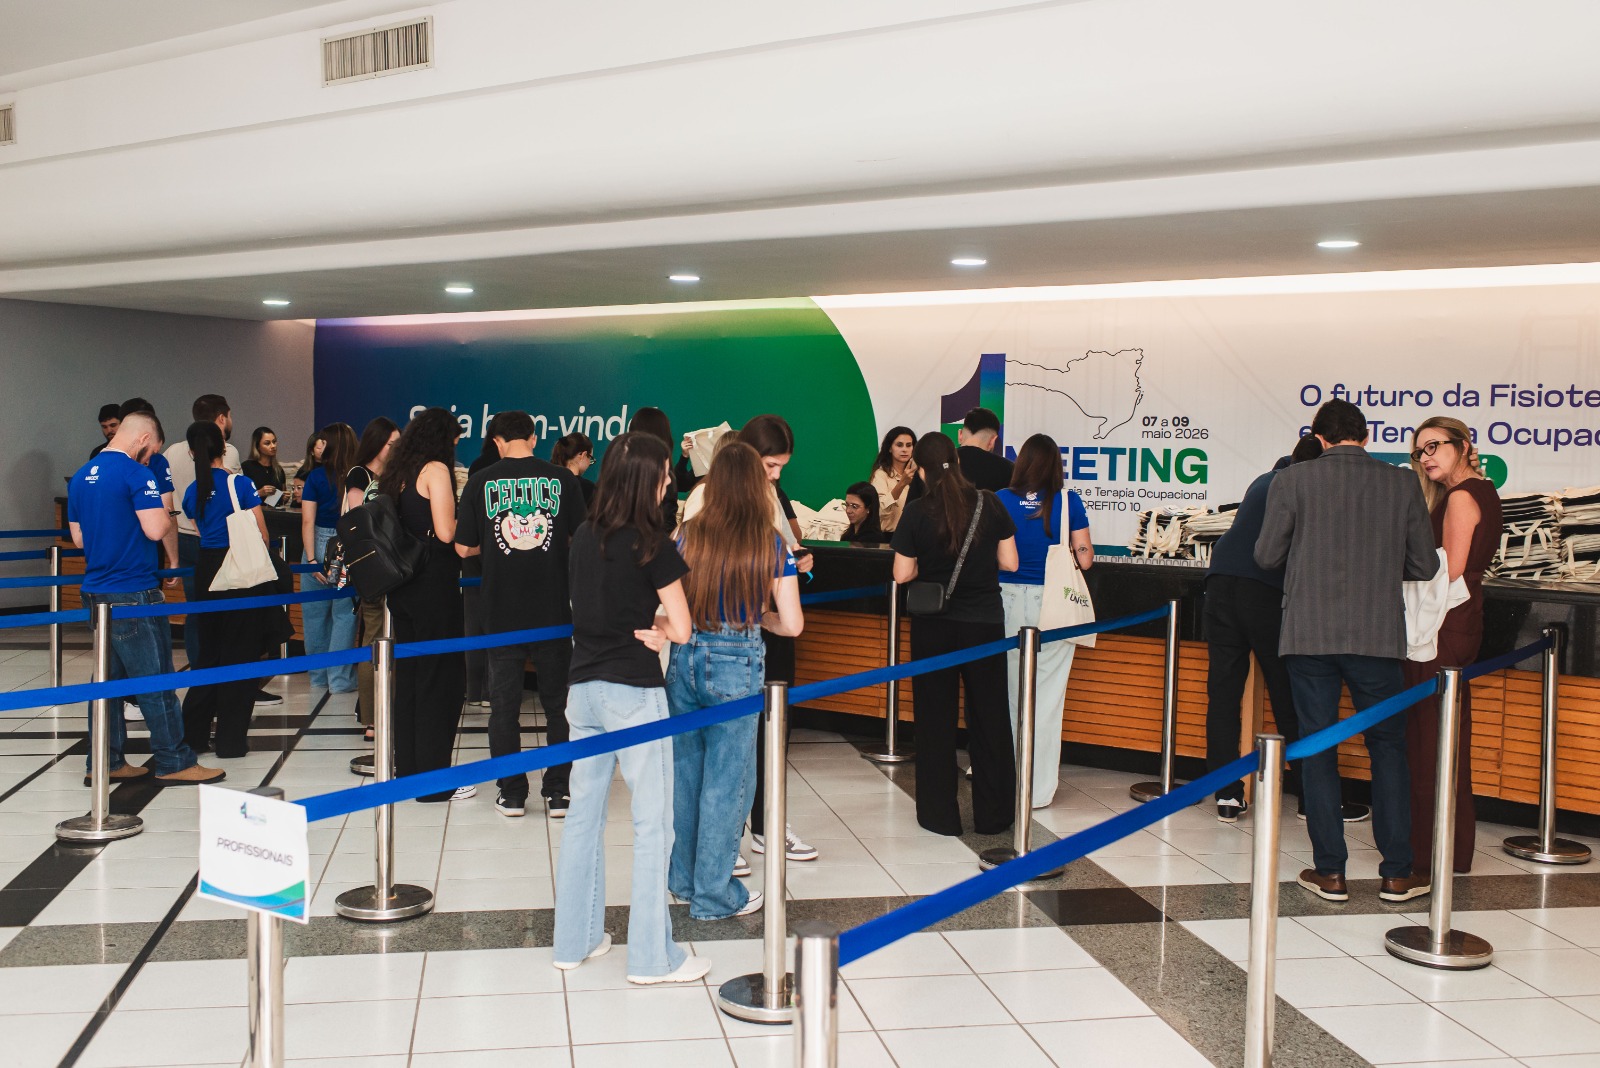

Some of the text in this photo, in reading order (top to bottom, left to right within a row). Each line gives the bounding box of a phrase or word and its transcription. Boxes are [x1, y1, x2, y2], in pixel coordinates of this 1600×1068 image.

[1300, 384, 1322, 407] O
[1330, 383, 1433, 407] futuro
[1443, 383, 1480, 407] da
[1141, 428, 1209, 439] maio 2026
[1142, 415, 1189, 427] 07 a 09
[1005, 445, 1209, 485] ETING
[485, 477, 561, 520] CELTICS
[1085, 488, 1092, 496] e
[1095, 486, 1135, 499] Terapia
[1137, 488, 1207, 500] Ocupacional
[1130, 502, 1141, 512] 10
[494, 515, 512, 556] BOSTON
[541, 512, 554, 552] CELTICS
[216, 837, 294, 867] PROFISSIONAIS
